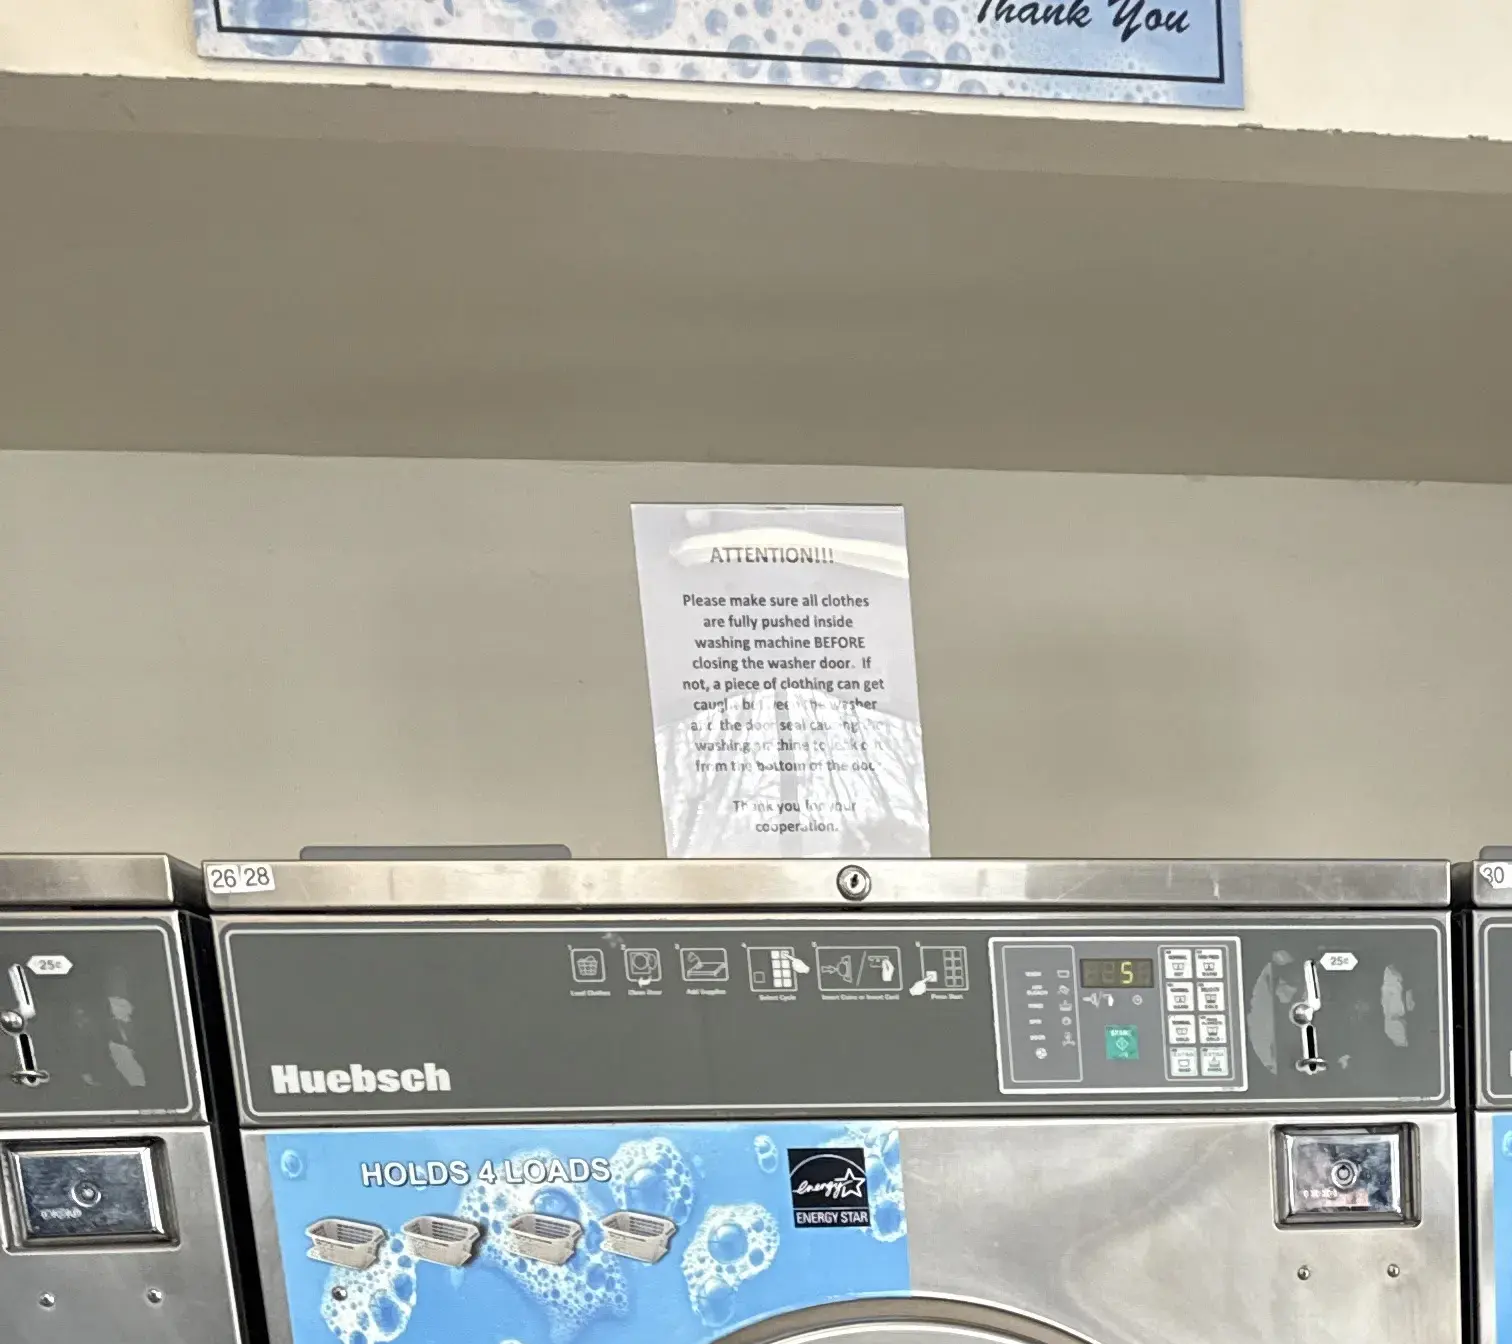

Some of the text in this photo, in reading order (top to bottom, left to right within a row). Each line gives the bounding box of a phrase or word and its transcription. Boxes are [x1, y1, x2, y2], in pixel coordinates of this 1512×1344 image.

[709, 547, 834, 564] ATTENTION!!!
[682, 593, 869, 607] Please make sure all clothes
[703, 615, 853, 630] are fully pushed inside
[695, 636, 865, 651] washing machine BEFORE
[692, 656, 872, 672] closing the washer door. If
[682, 677, 885, 692] not, a piece of clothing can get
[693, 698, 738, 713] caug
[742, 698, 801, 711] beee
[691, 719, 716, 731] ad
[720, 718, 742, 731] the
[809, 718, 858, 733] caung
[753, 739, 809, 751] mchine
[757, 759, 805, 772] bottom
[827, 759, 849, 772] the
[852, 759, 882, 772] doo
[777, 801, 800, 814] you
[829, 801, 857, 814] our
[755, 819, 839, 835] cooperation.
[211, 866, 270, 888] 26 28
[1483, 866, 1504, 884] 30
[1119, 961, 1134, 984] 5
[271, 1063, 451, 1094] Huebsch
[361, 1157, 613, 1187] HOLDS 4 LOADS
[796, 1211, 869, 1224] ENERGY STAR
